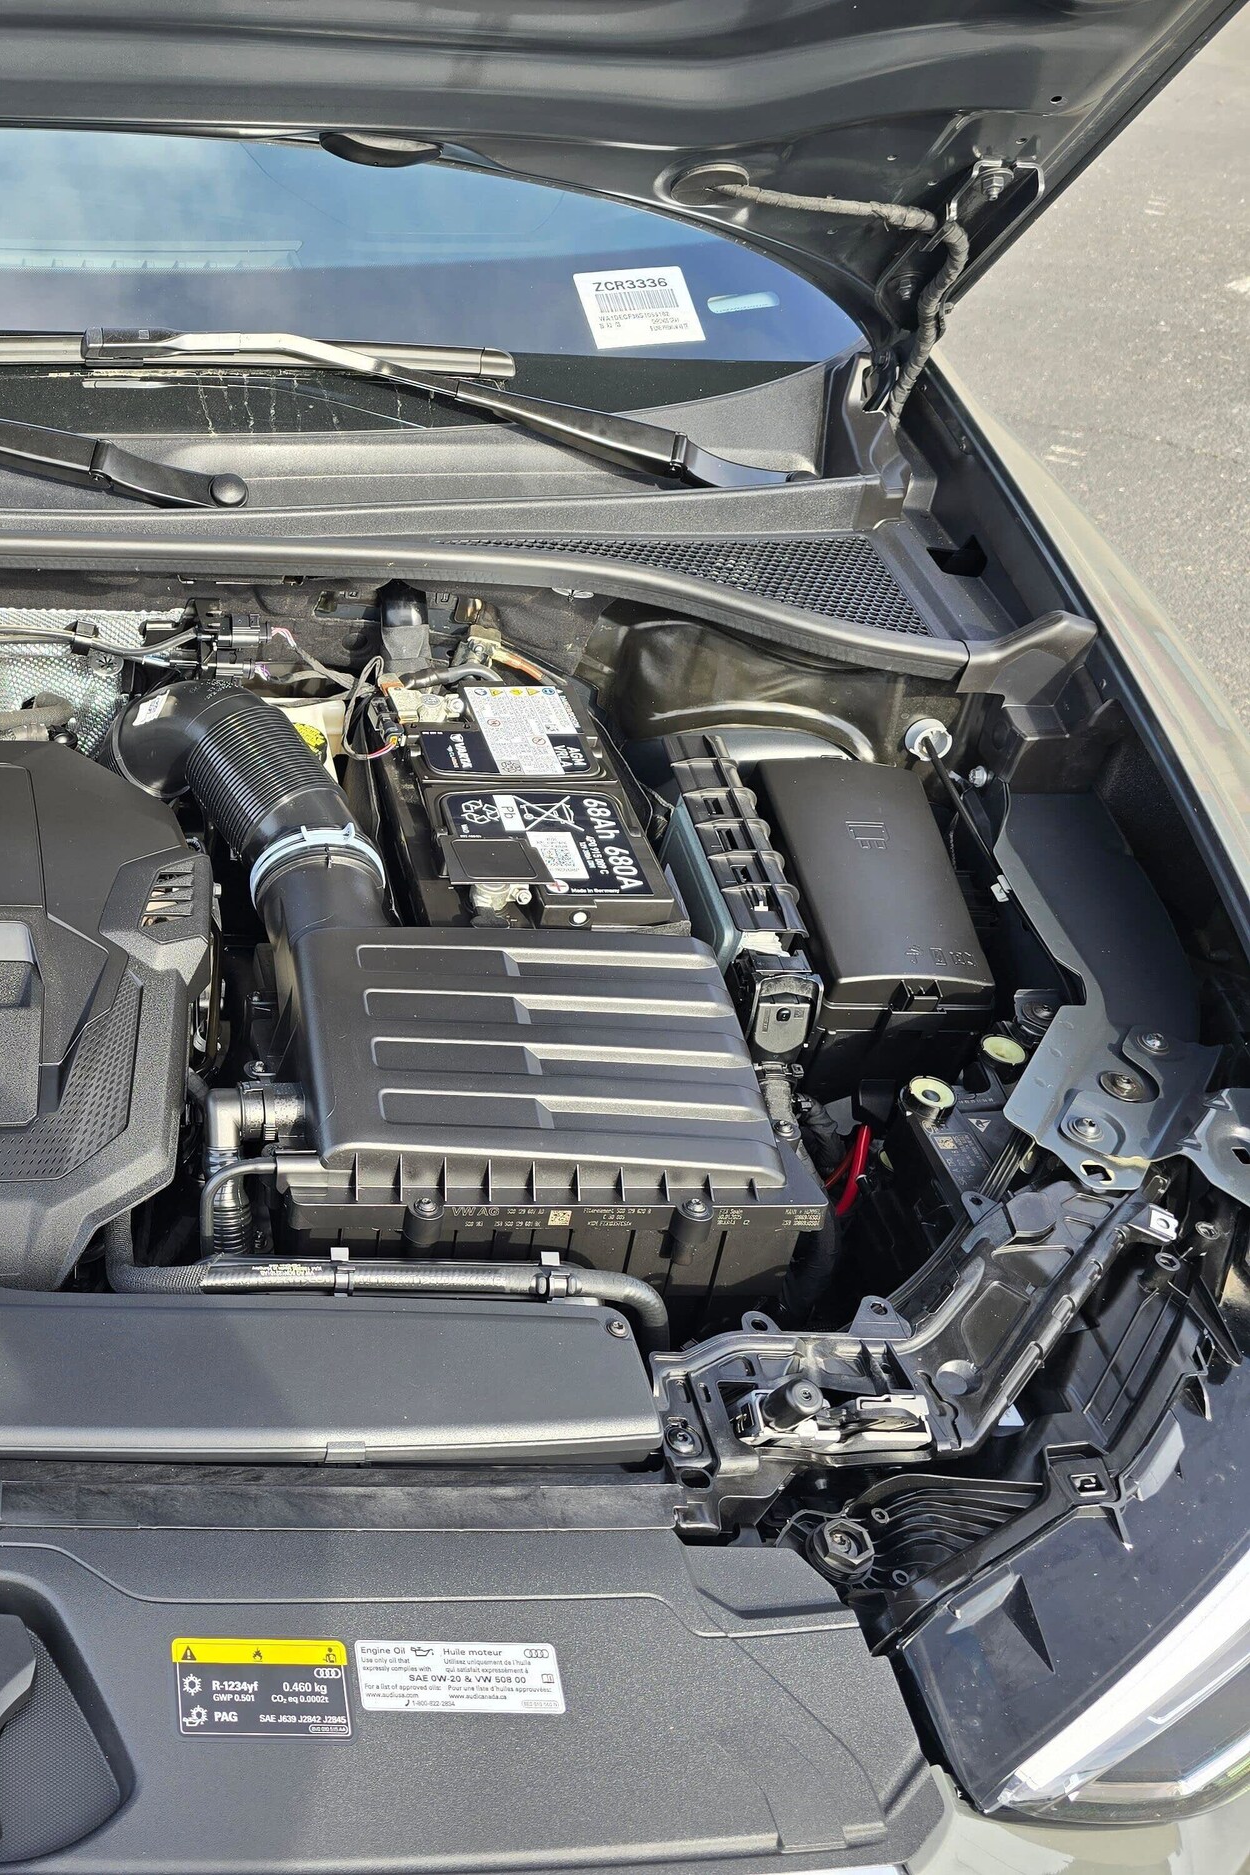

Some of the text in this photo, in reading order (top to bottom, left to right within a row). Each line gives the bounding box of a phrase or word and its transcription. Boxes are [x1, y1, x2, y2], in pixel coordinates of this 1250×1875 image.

[592, 278, 668, 292] ZCR3336
[455, 742, 472, 768] VARTA
[553, 745, 573, 767] VRLA
[567, 746, 587, 765] AGM
[501, 805, 517, 818] Pb
[583, 798, 644, 889] 68Ah 680A
[452, 1207, 500, 1216] VW AG
[360, 1647, 391, 1655] Engine
[443, 1648, 465, 1656] Huile
[212, 1680, 327, 1694] R-1234yf 0.460 kg
[213, 1694, 255, 1702] GWP 0.501
[288, 1696, 299, 1705] eq
[299, 1695, 329, 1703] 0.0002t
[214, 1711, 239, 1722] PAG
[259, 1714, 347, 1724] SAE J639 J2842 J2845
